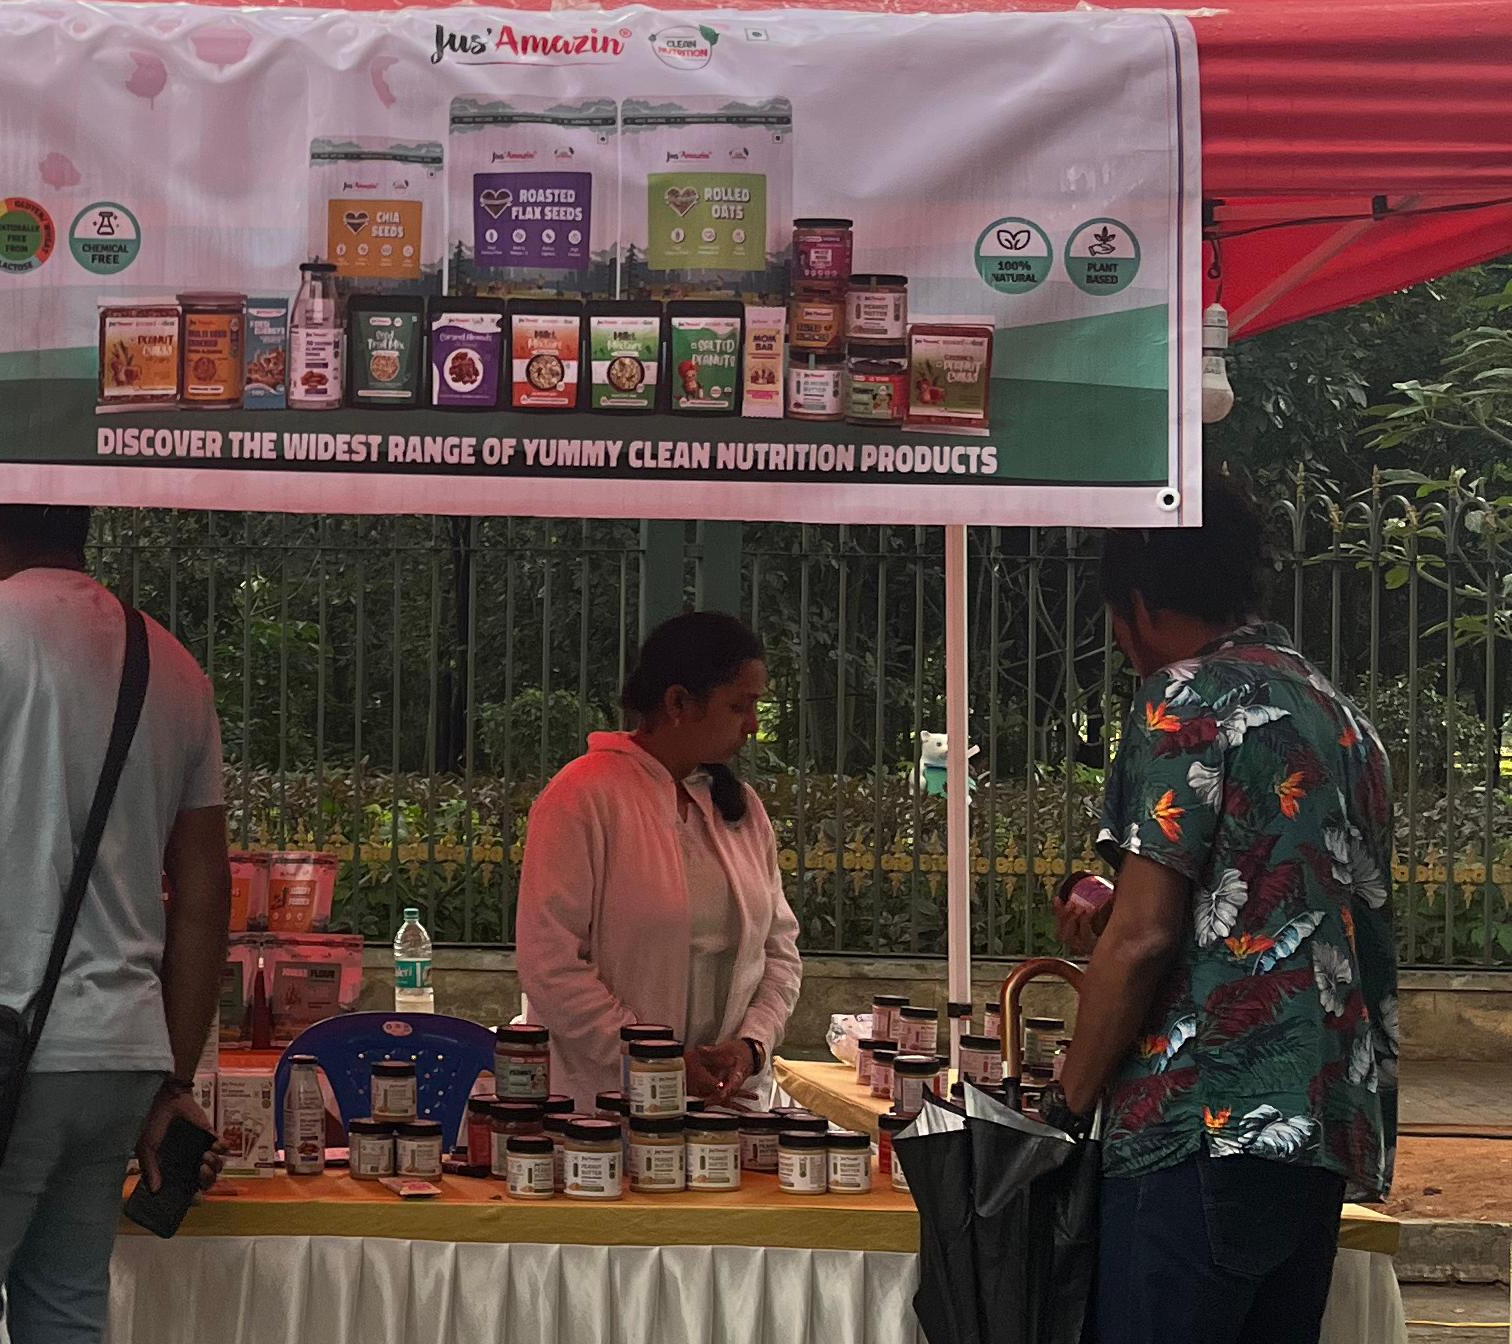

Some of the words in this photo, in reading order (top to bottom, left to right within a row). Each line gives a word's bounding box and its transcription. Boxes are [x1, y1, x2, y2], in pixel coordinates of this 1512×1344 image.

[666, 40, 697, 49] CLEAN
[519, 189, 575, 203] ROASTED
[704, 187, 750, 202] ROLLED
[376, 212, 400, 224] CHIA
[511, 206, 542, 220] FLAX
[544, 207, 583, 221] SEEDS
[711, 205, 744, 220] OATS
[371, 226, 405, 238] SEEDS
[5, 245, 28, 253] FROM
[82, 243, 129, 254] CHEMICAL
[91, 254, 120, 265] FREE
[997, 261, 1031, 271] 100%
[1088, 263, 1119, 273] PLANT
[992, 273, 1038, 283] NATURAL
[1086, 274, 1119, 284] BASED
[752, 335, 777, 343] MOM
[697, 339, 735, 353] SALTED
[754, 343, 773, 351] BAR
[691, 354, 736, 368] PEANUTS
[97, 427, 222, 458] DISCOVER
[229, 431, 277, 460] THE
[283, 432, 382, 462] WIDEST
[388, 435, 477, 465] RANGE
[482, 438, 515, 466] OF
[523, 439, 622, 469] YUMMY
[627, 441, 711, 470] CLEAN
[716, 443, 855, 473] NUTRITION
[860, 444, 998, 474] PRODUCTS
